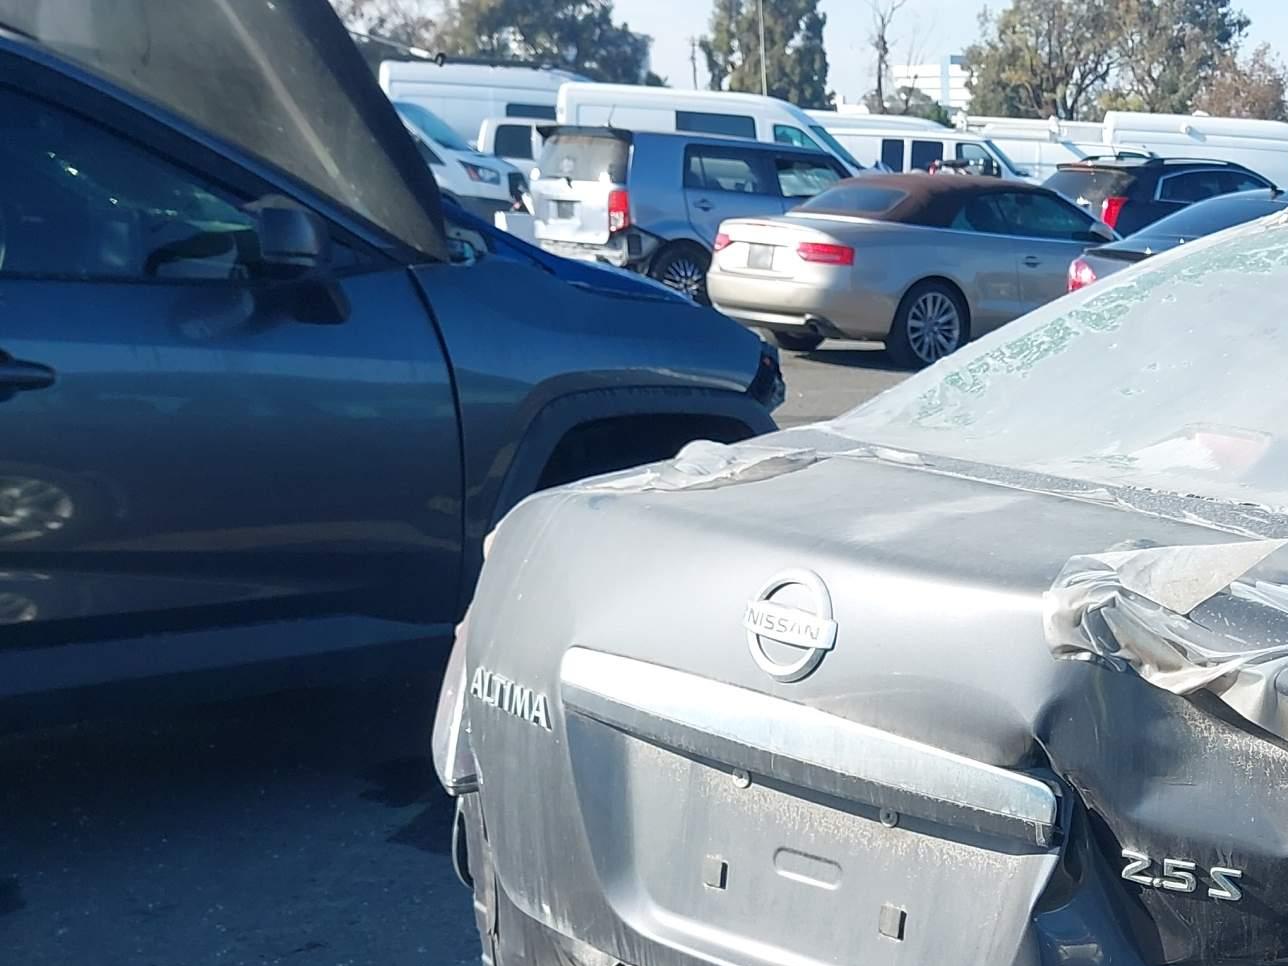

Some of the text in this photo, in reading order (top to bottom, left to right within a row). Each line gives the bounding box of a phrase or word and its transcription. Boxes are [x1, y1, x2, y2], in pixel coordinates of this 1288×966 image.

[746, 606, 820, 641] NISSAN
[470, 665, 553, 733] ALTIMA
[1121, 849, 1242, 901] 2.5 S
